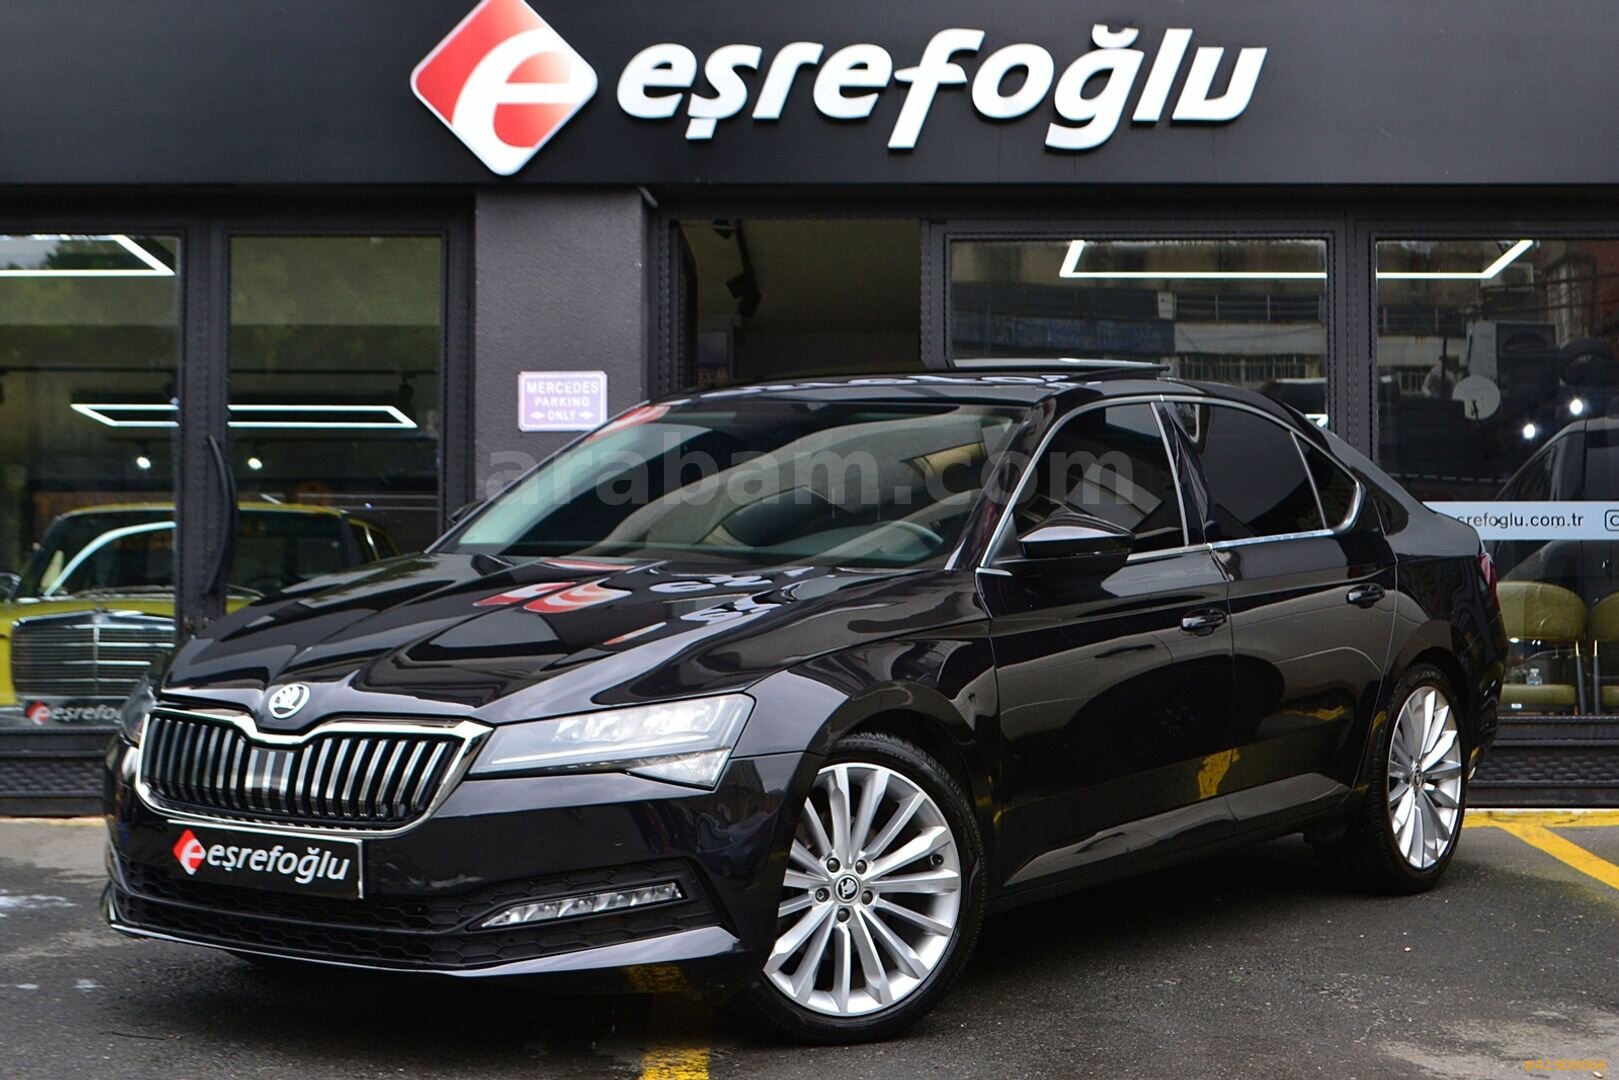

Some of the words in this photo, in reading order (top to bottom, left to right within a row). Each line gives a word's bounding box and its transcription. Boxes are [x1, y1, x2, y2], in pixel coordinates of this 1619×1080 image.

[616, 23, 1268, 148] eşrefoğlu
[526, 381, 600, 394] MERCEDES
[535, 396, 590, 408] PARKING
[547, 410, 577, 421] ONLY
[206, 843, 351, 884] eşrefoğlu
